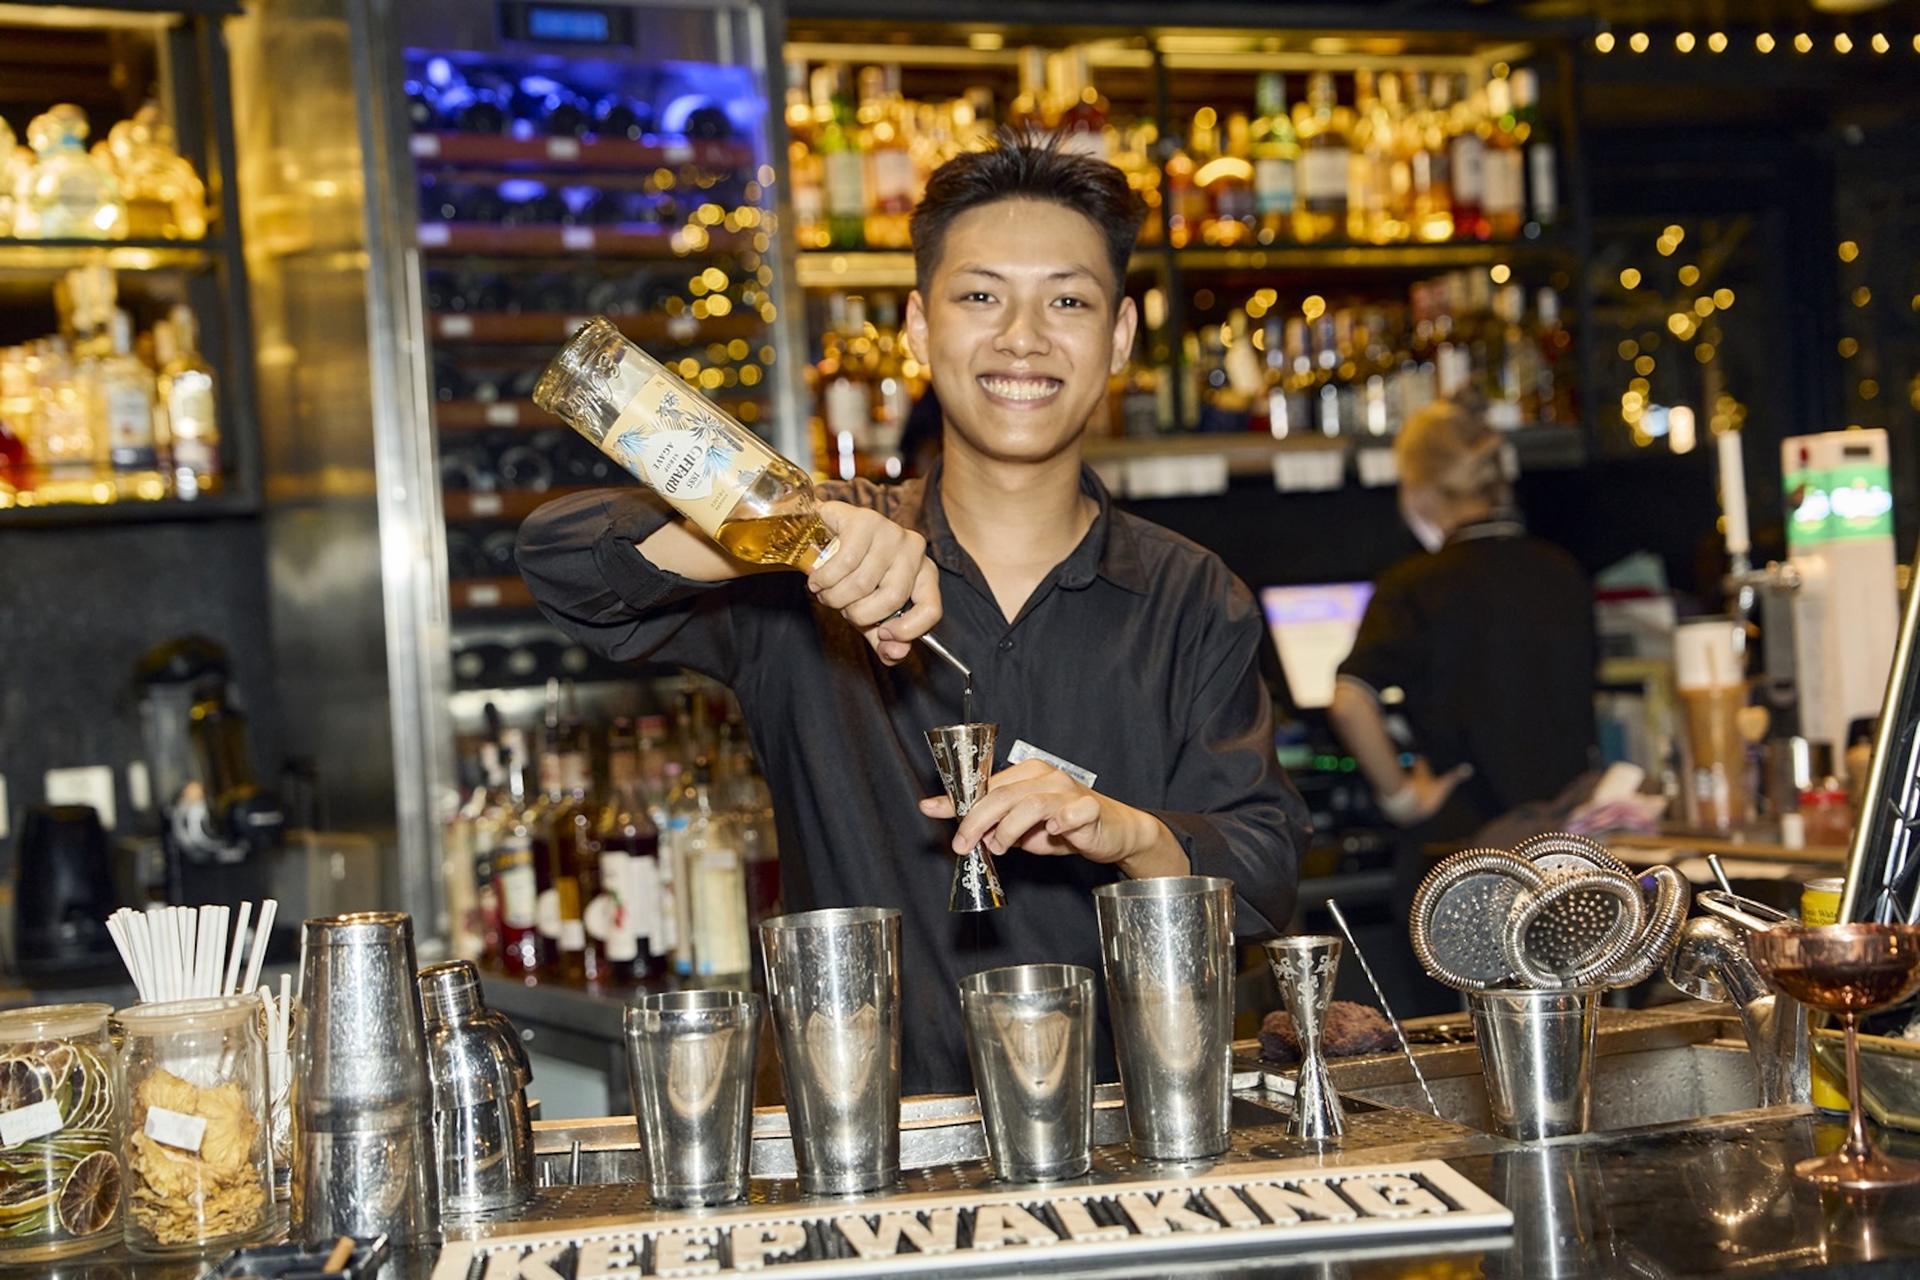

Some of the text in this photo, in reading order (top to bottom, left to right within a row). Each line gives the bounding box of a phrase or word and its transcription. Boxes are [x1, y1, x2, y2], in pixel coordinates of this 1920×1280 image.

[652, 441, 674, 470] AGAVE
[665, 445, 703, 493] GIFFARD
[484, 1174, 1448, 1280] KEEP WALKING
